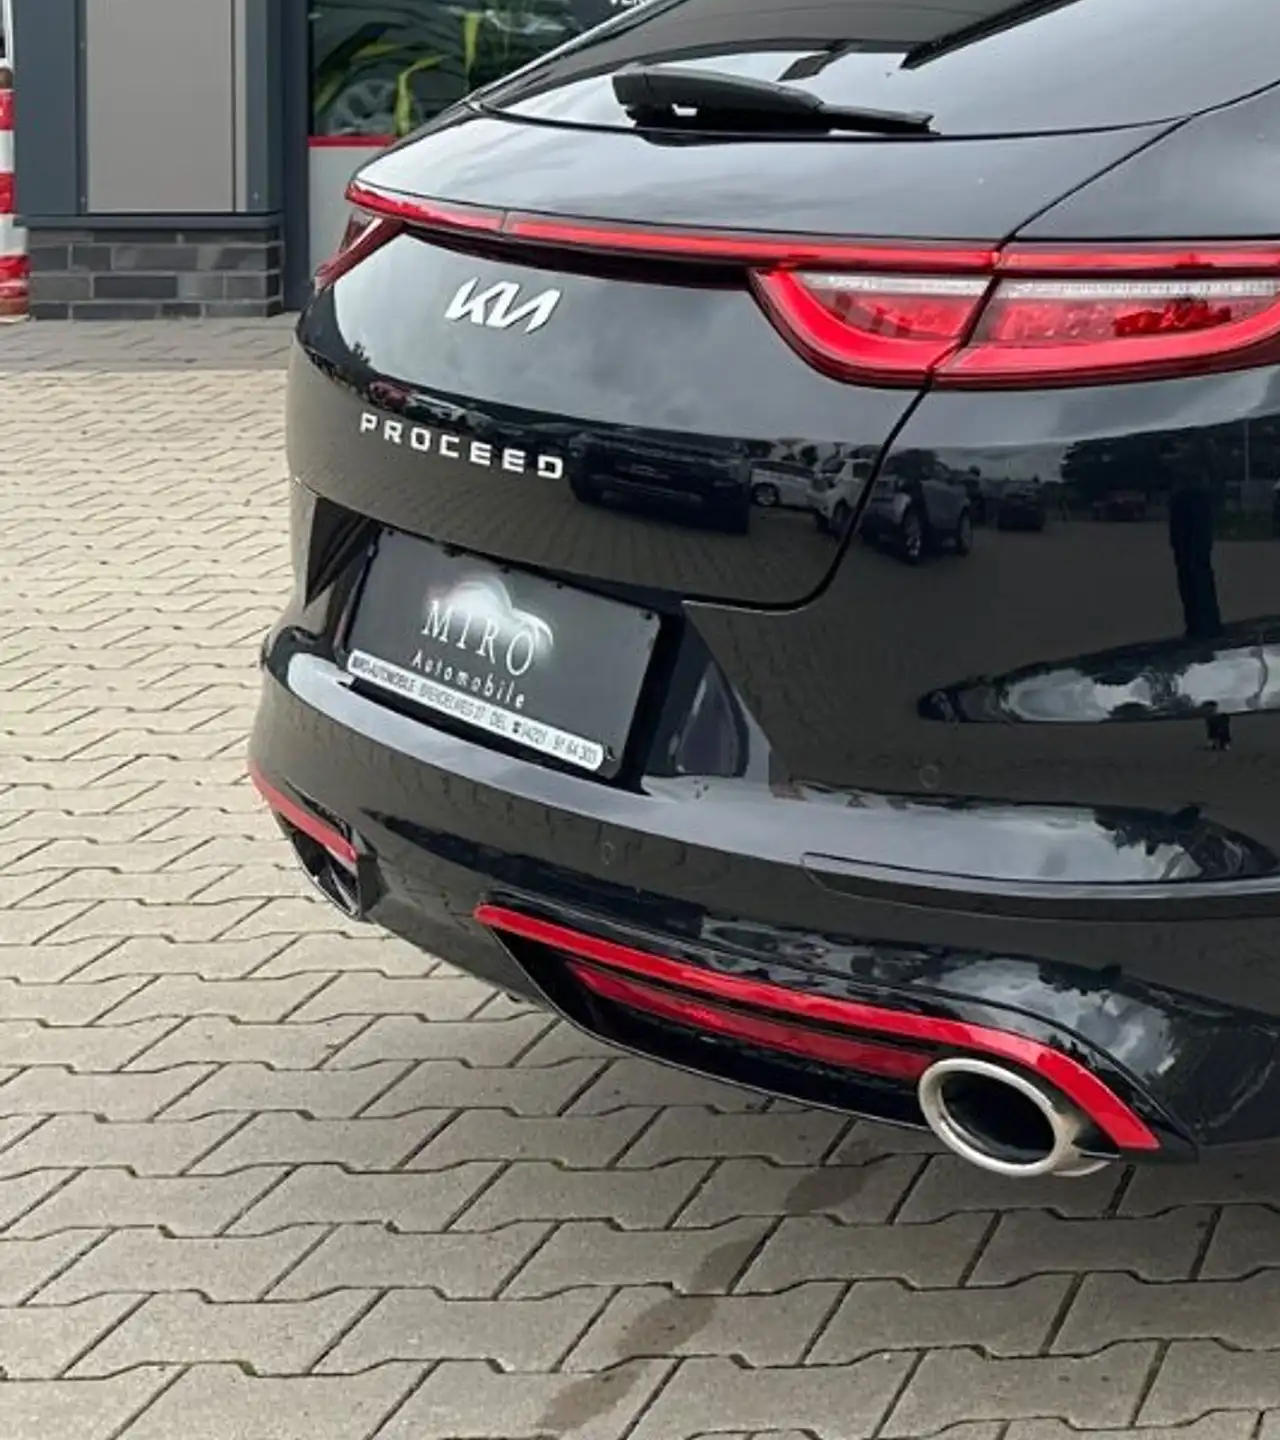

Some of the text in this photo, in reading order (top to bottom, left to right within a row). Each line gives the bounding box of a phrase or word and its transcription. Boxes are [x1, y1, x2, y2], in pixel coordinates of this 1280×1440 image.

[360, 412, 564, 479] PROCEED
[421, 600, 534, 675] MIRO
[411, 649, 525, 709] Automobile
